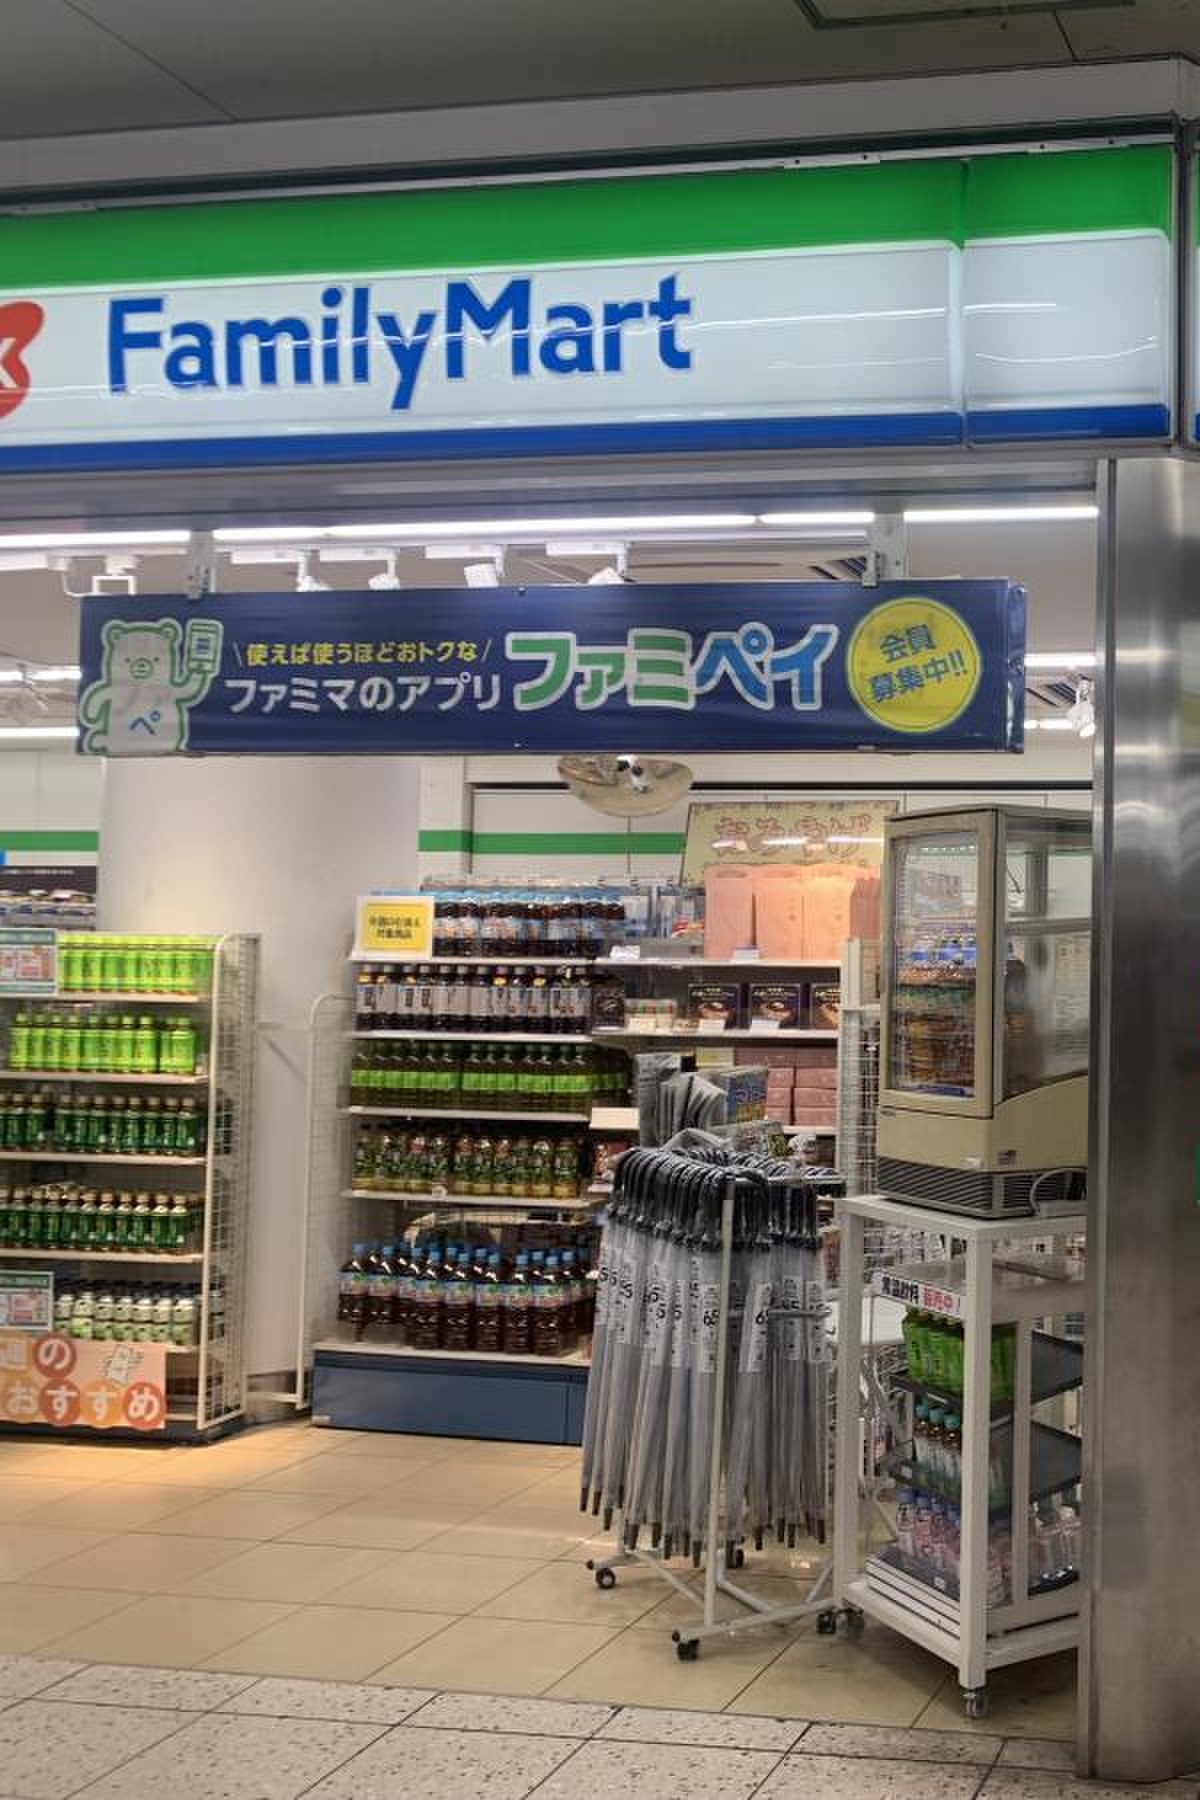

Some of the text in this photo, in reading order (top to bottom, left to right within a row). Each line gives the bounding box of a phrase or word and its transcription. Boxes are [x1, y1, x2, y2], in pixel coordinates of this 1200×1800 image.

[107, 272, 696, 411] FamilyMart
[246, 640, 478, 667] 使えば使うほどおトクな
[879, 623, 937, 665] 会員
[505, 622, 840, 711] ファミペイ
[224, 671, 501, 713] ファミマのアプリ
[5, 1380, 161, 1421] おすすめ
